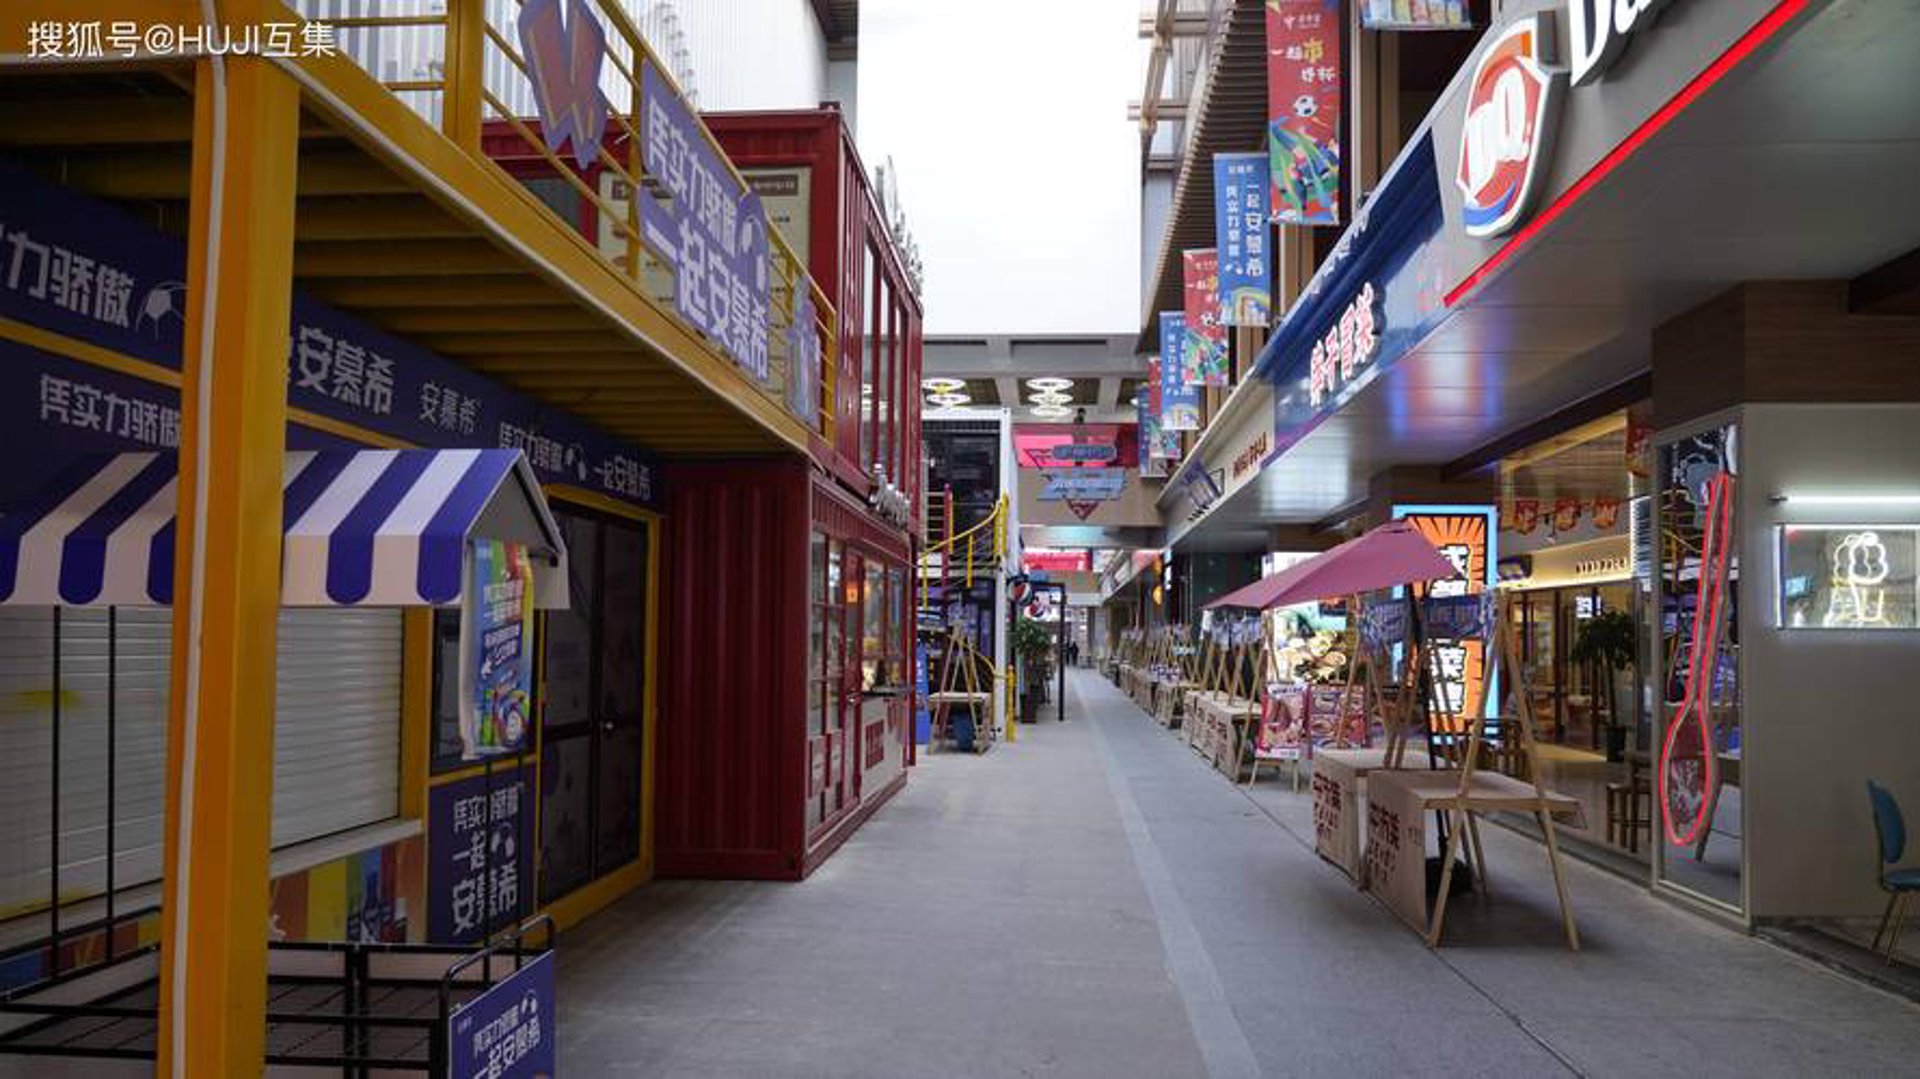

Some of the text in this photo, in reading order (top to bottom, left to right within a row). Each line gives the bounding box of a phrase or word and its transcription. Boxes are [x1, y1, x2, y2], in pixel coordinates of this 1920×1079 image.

[0, 222, 396, 415] 力骄傲 安慕希
[646, 217, 768, 379] 一起安慕希
[418, 380, 483, 435] 安慕希
